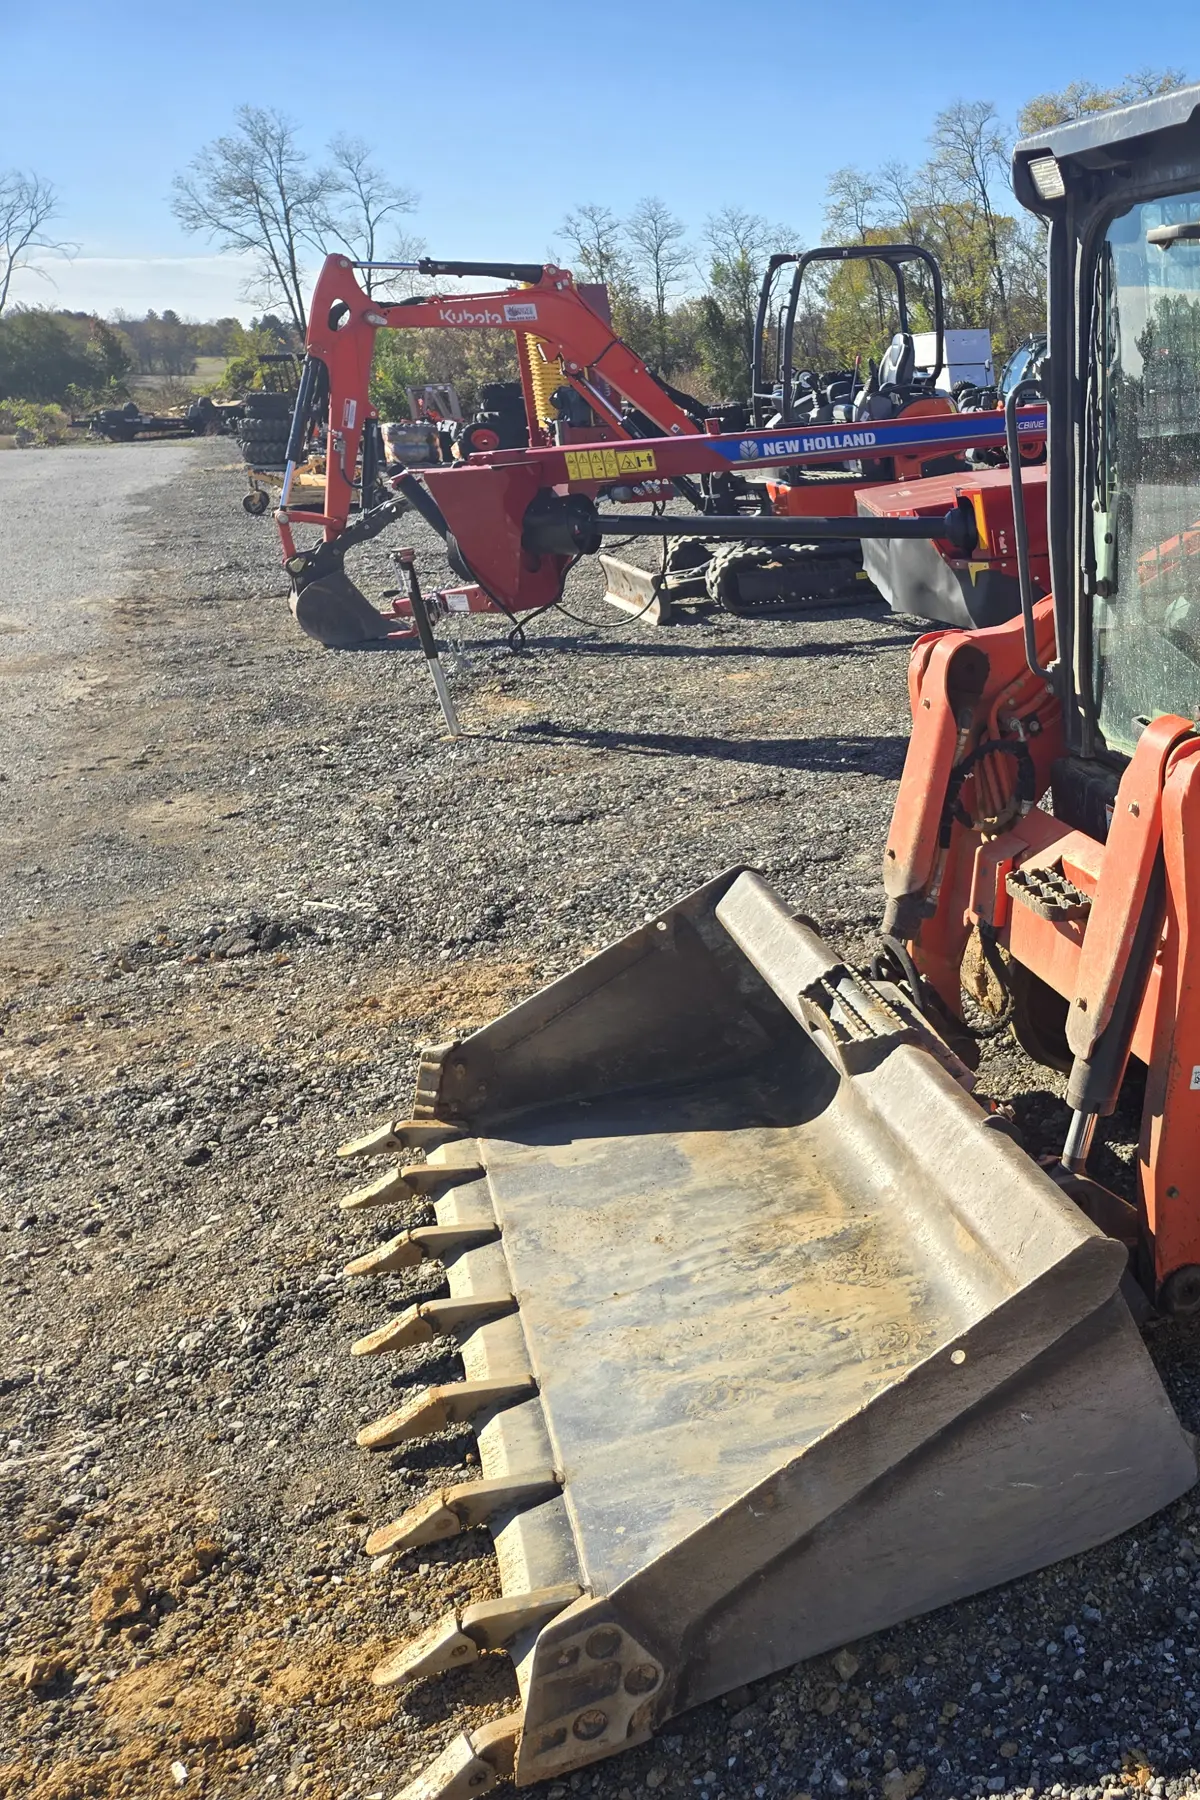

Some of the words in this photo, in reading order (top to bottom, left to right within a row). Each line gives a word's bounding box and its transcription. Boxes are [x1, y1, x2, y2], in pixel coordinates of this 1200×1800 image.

[439, 309, 503, 324] Kubota
[763, 440, 800, 456] NEW
[803, 432, 876, 451] HOLLAND
